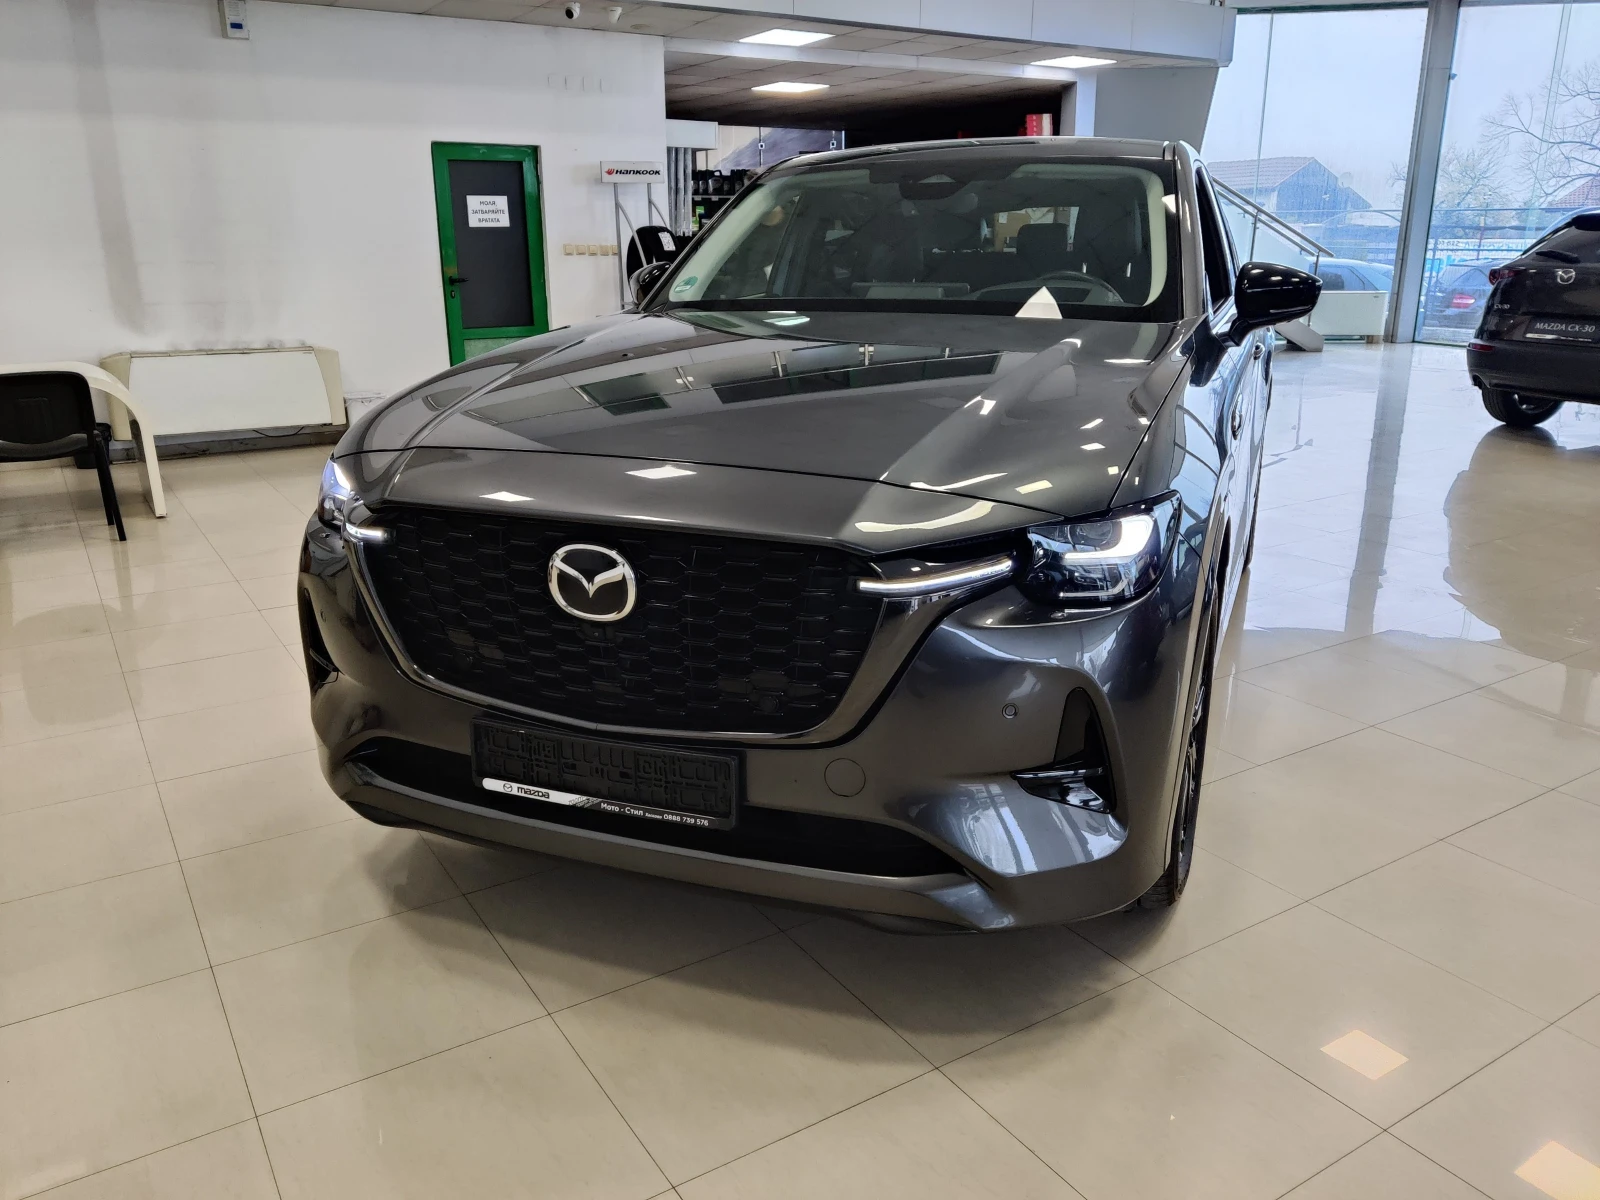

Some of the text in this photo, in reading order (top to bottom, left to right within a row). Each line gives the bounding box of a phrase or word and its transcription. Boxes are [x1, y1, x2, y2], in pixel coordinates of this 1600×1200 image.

[1534, 322, 1596, 333] MAZDA CX-30
[600, 802, 619, 812] Мото
[625, 807, 644, 816] Стил
[663, 813, 681, 822] 0888
[682, 816, 695, 824] 739
[696, 818, 709, 827] 576
